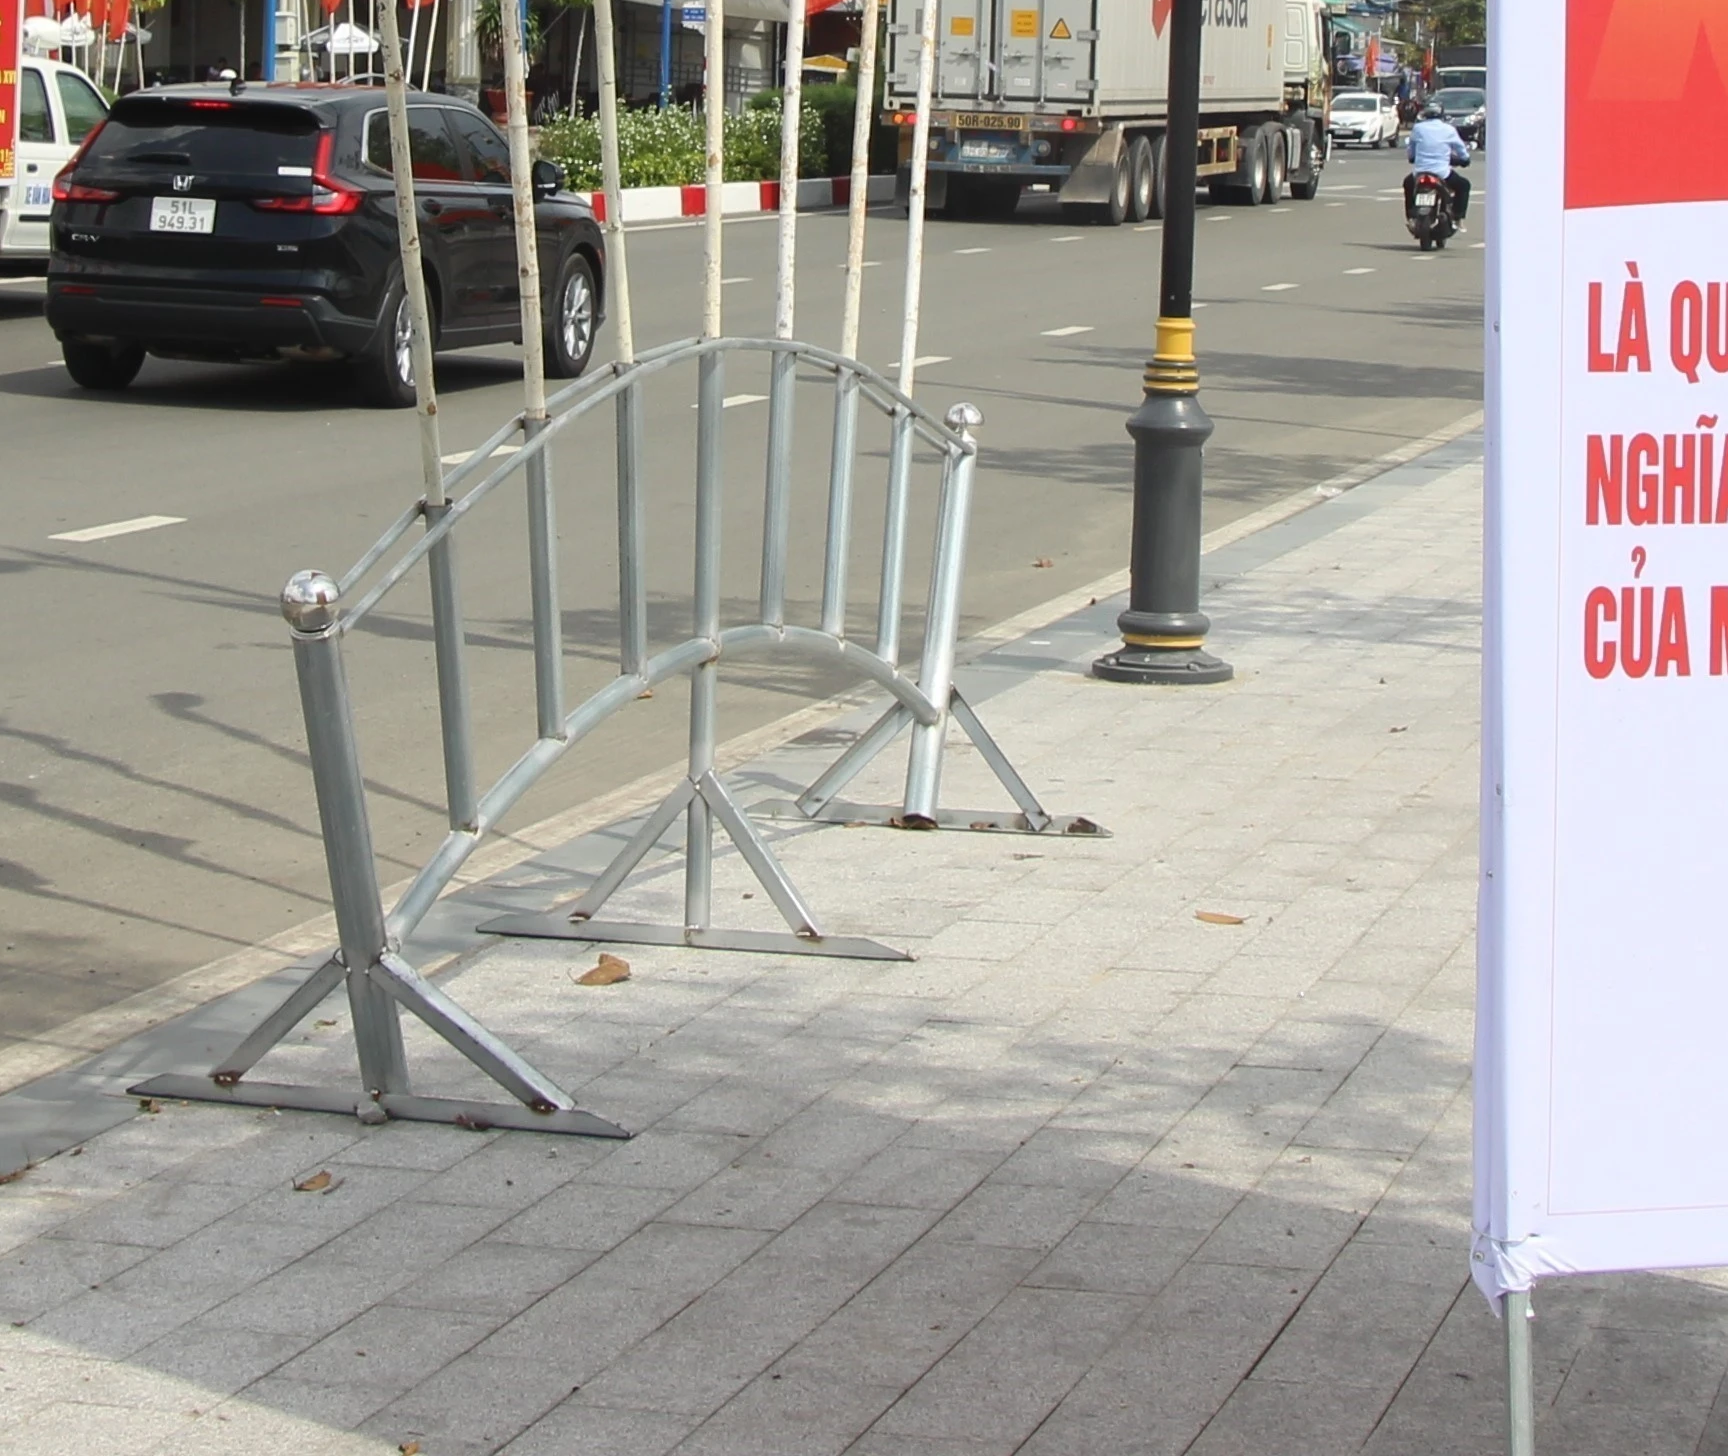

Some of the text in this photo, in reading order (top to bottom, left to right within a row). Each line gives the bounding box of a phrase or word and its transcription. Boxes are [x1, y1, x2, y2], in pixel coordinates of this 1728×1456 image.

[958, 116, 1021, 128] 50R-025.90
[171, 201, 196, 215] 51L
[158, 216, 205, 231] 949.31
[1588, 262, 1651, 372] LÀ
[1585, 547, 1690, 679] CỦA
